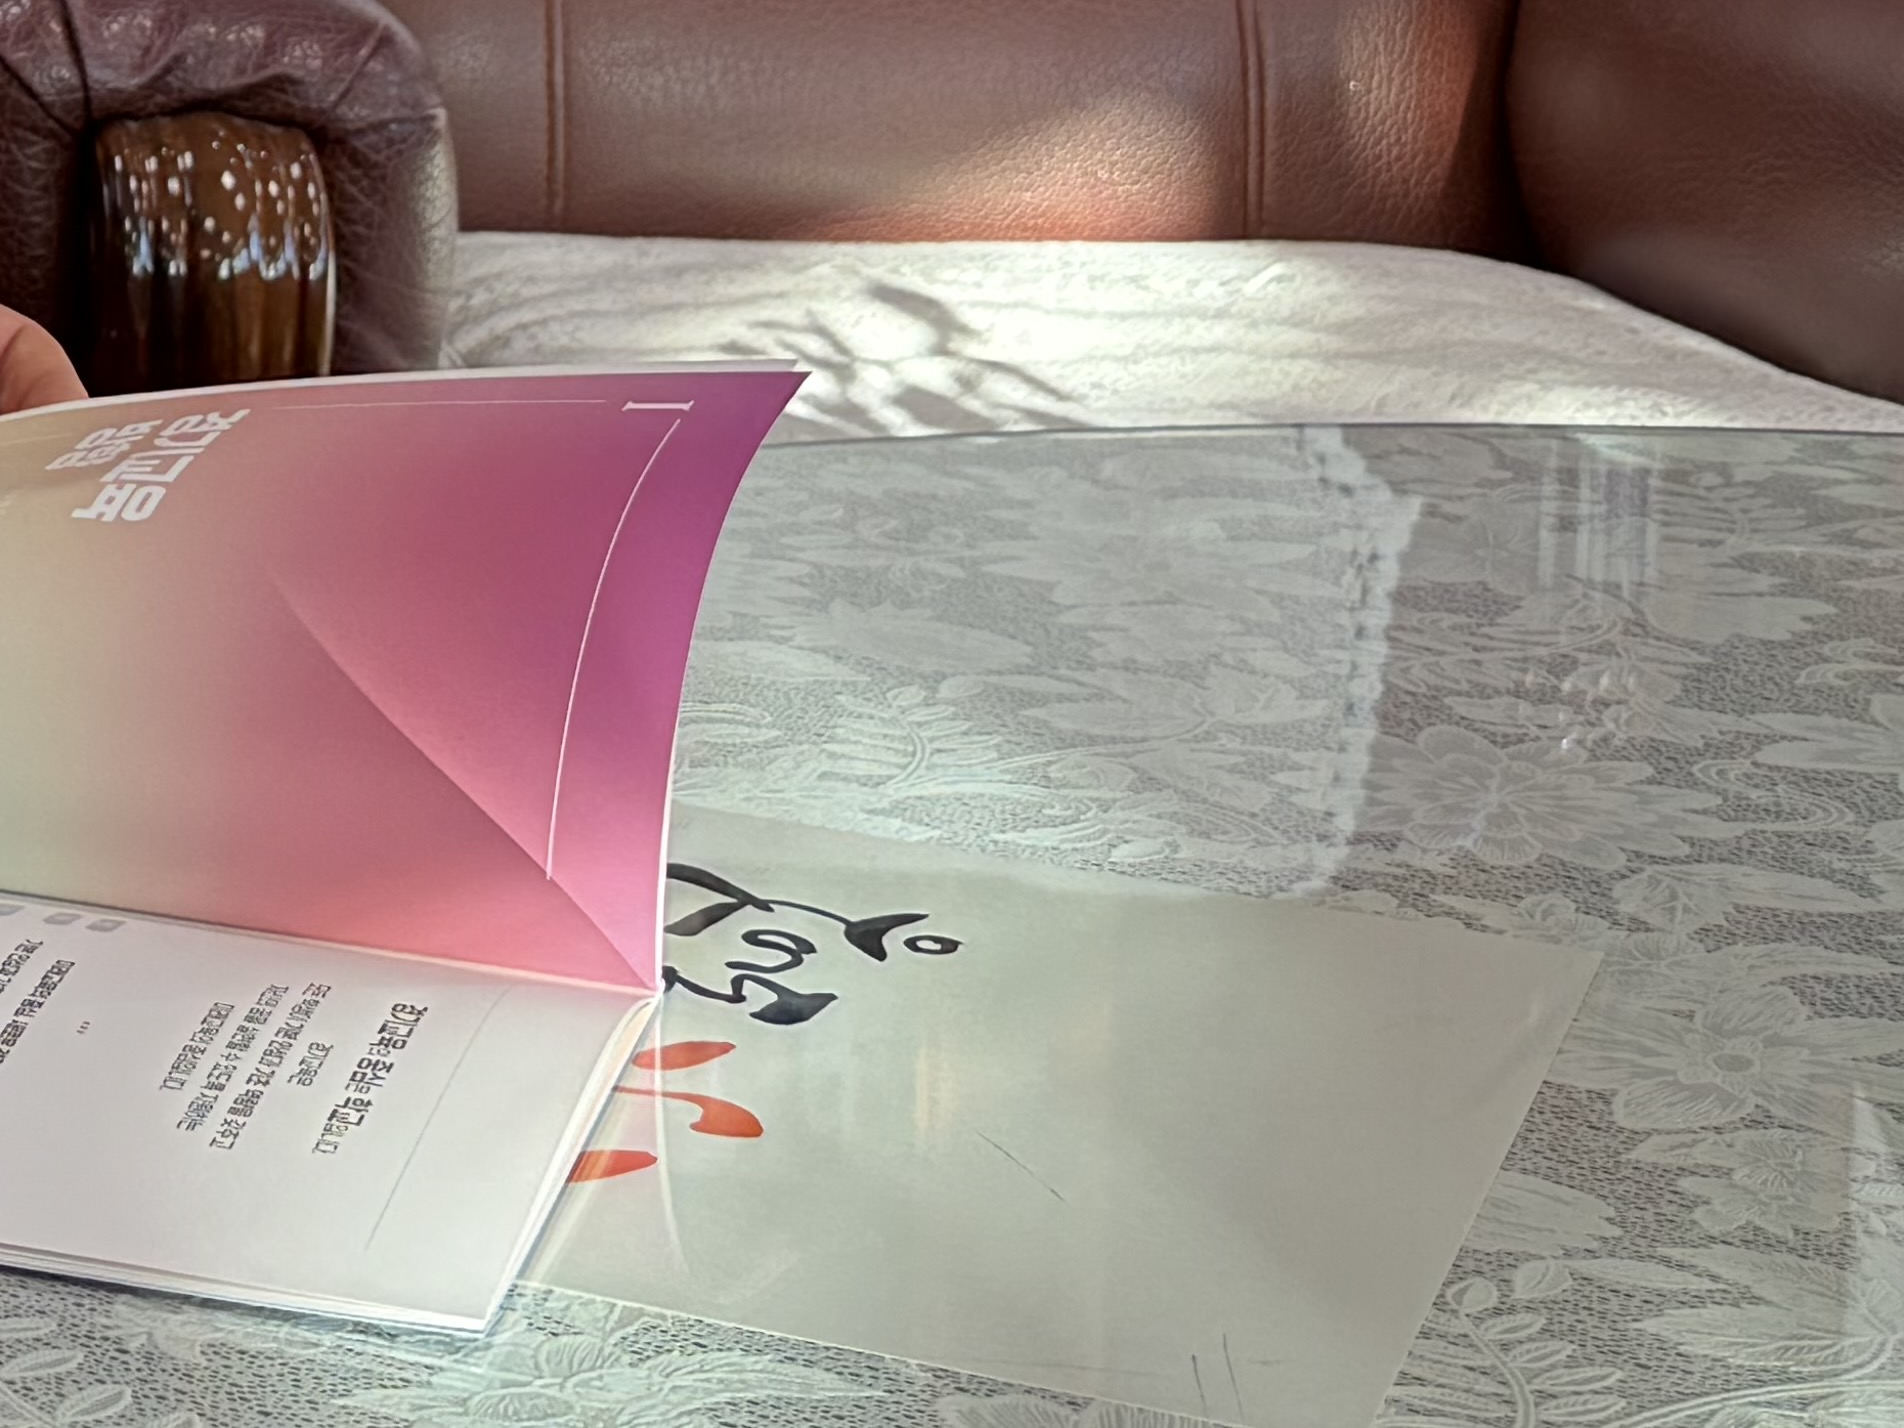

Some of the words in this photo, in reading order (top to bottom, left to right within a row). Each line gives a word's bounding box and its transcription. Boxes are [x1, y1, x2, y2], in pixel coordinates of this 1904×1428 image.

[44, 418, 163, 471] 방향
[71, 408, 252, 523] 경기교육
[368, 1004, 428, 1057] 경기교육의
[345, 1058, 394, 1094] 중심은
[209, 1118, 246, 1149] 갖추고
